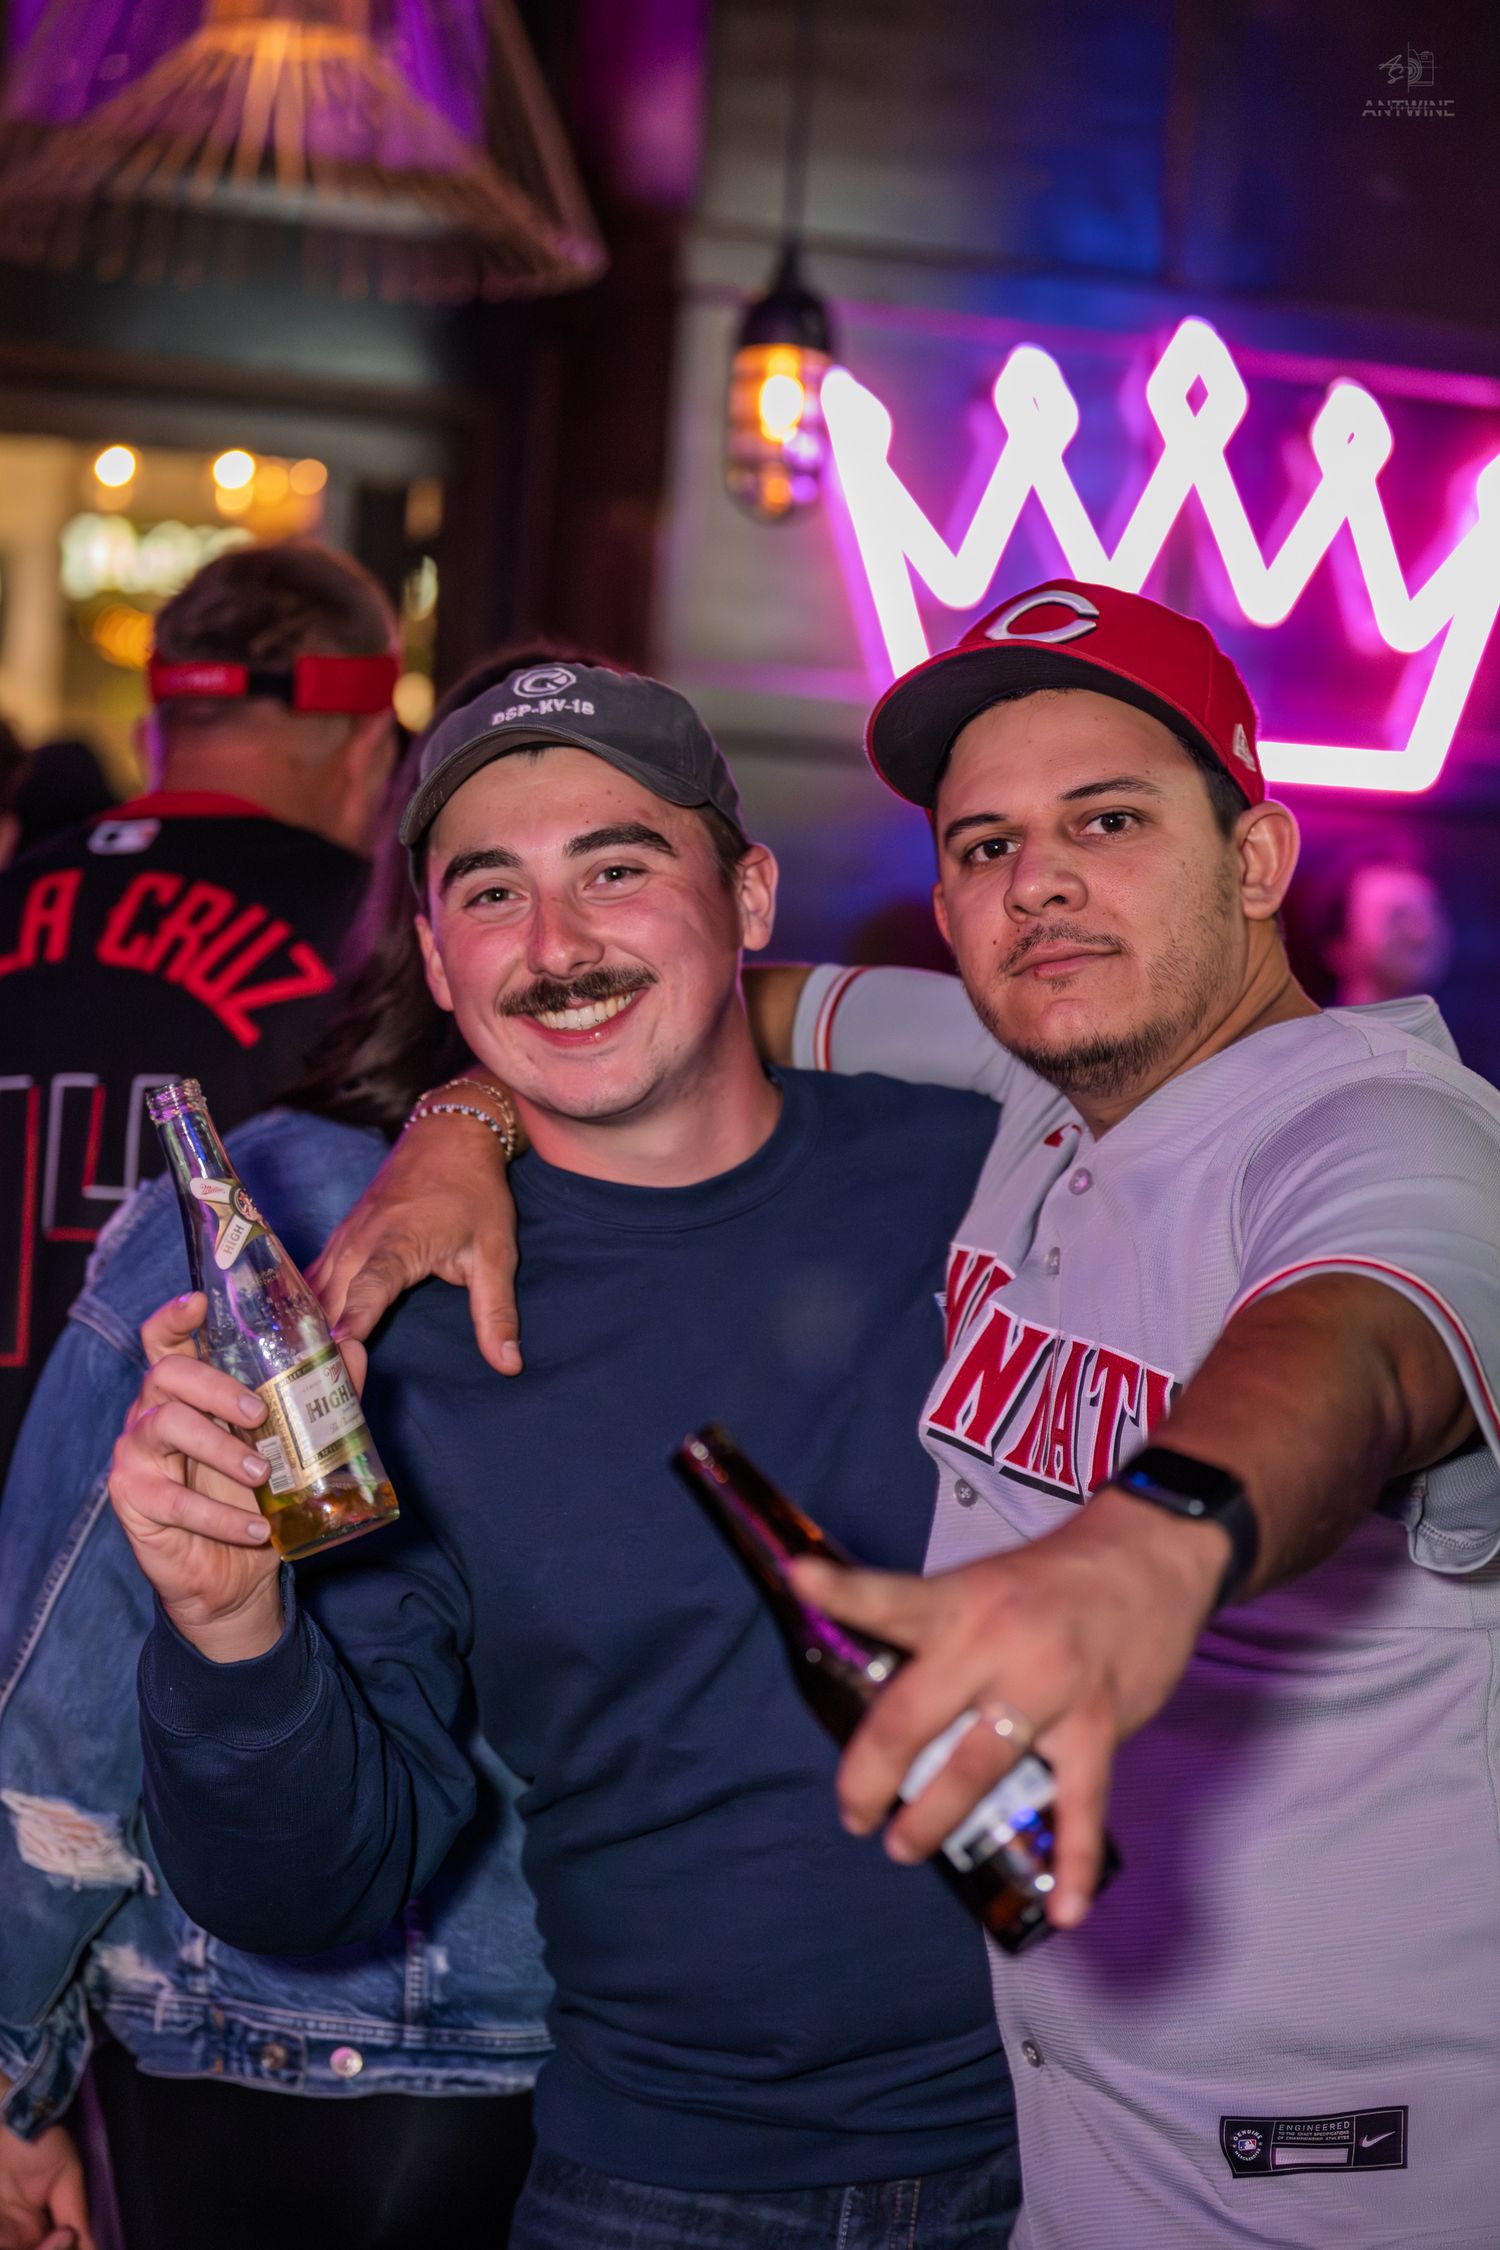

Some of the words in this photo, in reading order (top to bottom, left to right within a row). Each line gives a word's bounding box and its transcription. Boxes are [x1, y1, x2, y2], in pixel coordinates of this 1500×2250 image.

[984, 589, 1100, 645] C
[94, 869, 337, 1050] CRUZ
[223, 1224, 245, 1255] HIGH
[1233, 2129, 1263, 2141] GENUINE
[1278, 2121, 1350, 2131] ENGINEERED
